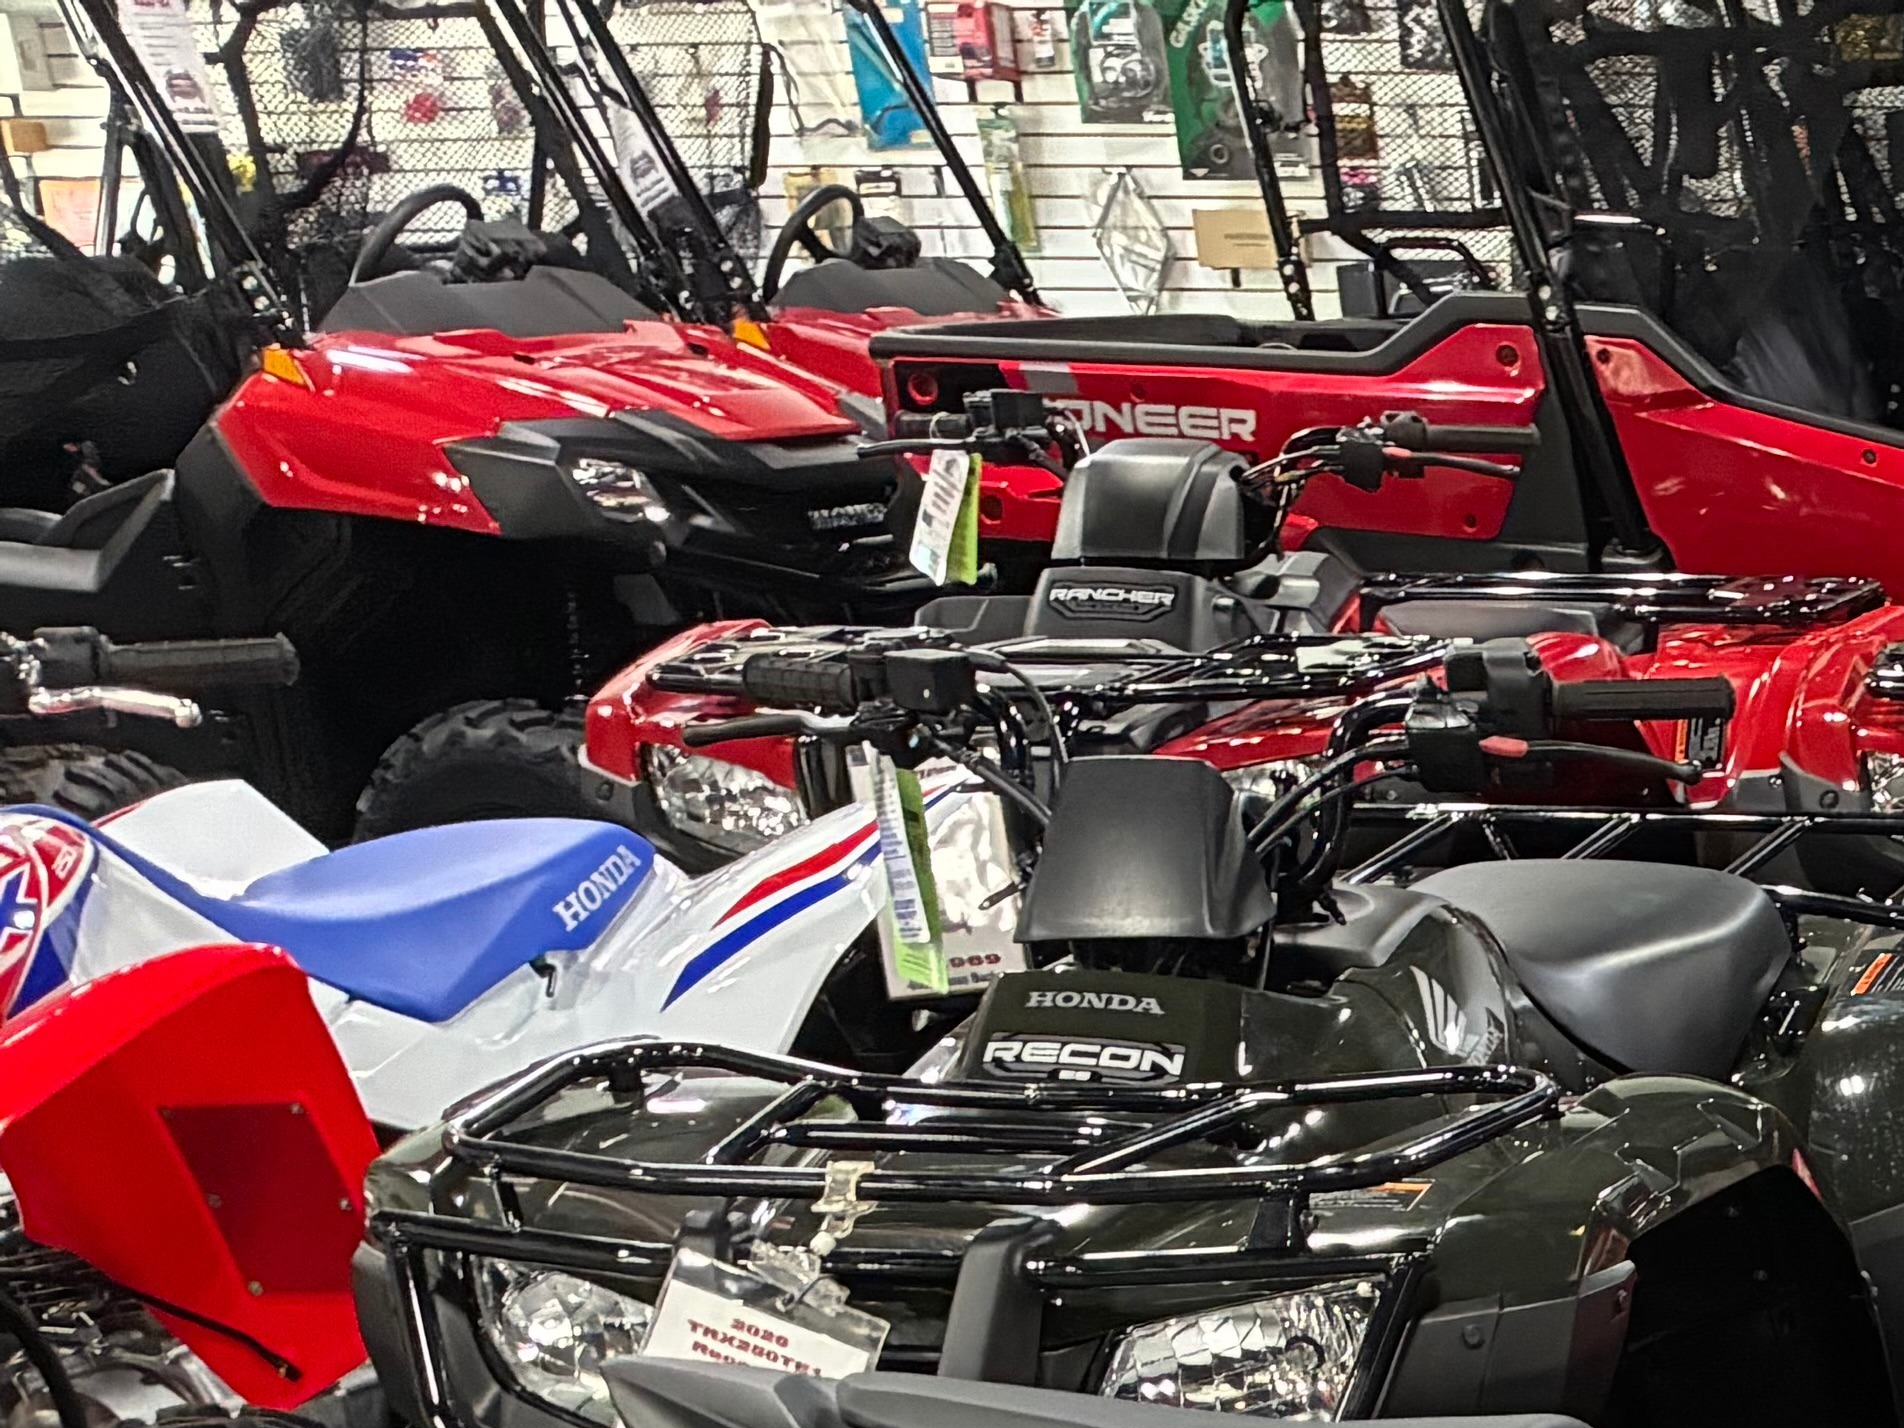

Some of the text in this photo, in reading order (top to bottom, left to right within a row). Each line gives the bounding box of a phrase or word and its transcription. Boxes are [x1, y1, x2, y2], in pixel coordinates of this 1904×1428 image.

[1042, 397, 1257, 442] ONEER
[1049, 587, 1176, 607] RANCHER
[552, 844, 642, 932] HONDA
[1024, 991, 1166, 1016] HONDA
[982, 1041, 1186, 1077] RECON
